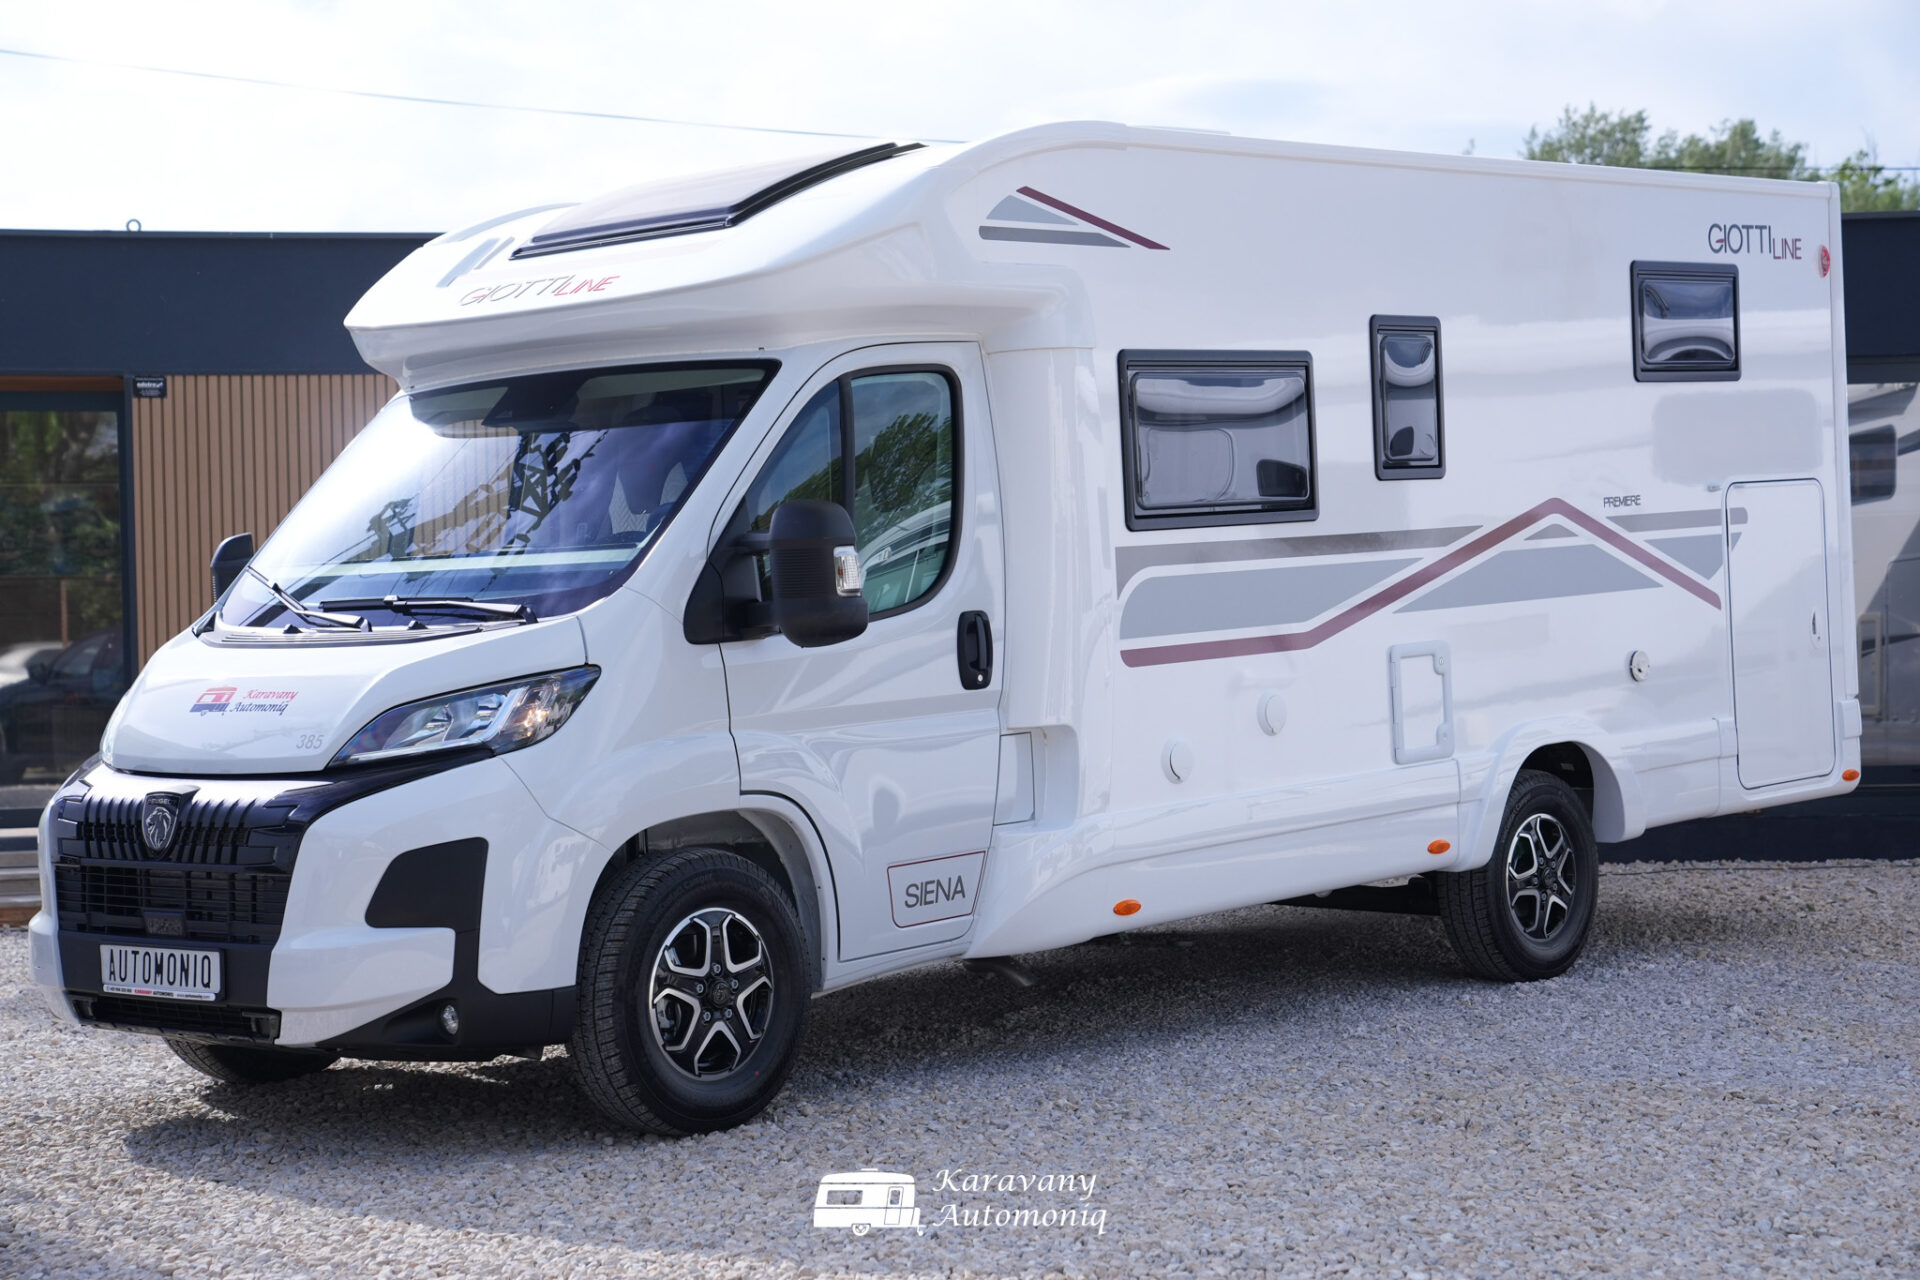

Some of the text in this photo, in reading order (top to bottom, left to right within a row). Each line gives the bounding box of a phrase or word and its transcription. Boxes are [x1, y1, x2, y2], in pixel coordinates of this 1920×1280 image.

[1603, 495, 1641, 509] PREMIERE
[243, 689, 299, 703] Karavany
[229, 701, 289, 716] Automoniq
[296, 734, 325, 750] 385
[904, 875, 966, 909] SIENA
[109, 948, 212, 989] AUTOMONIQ
